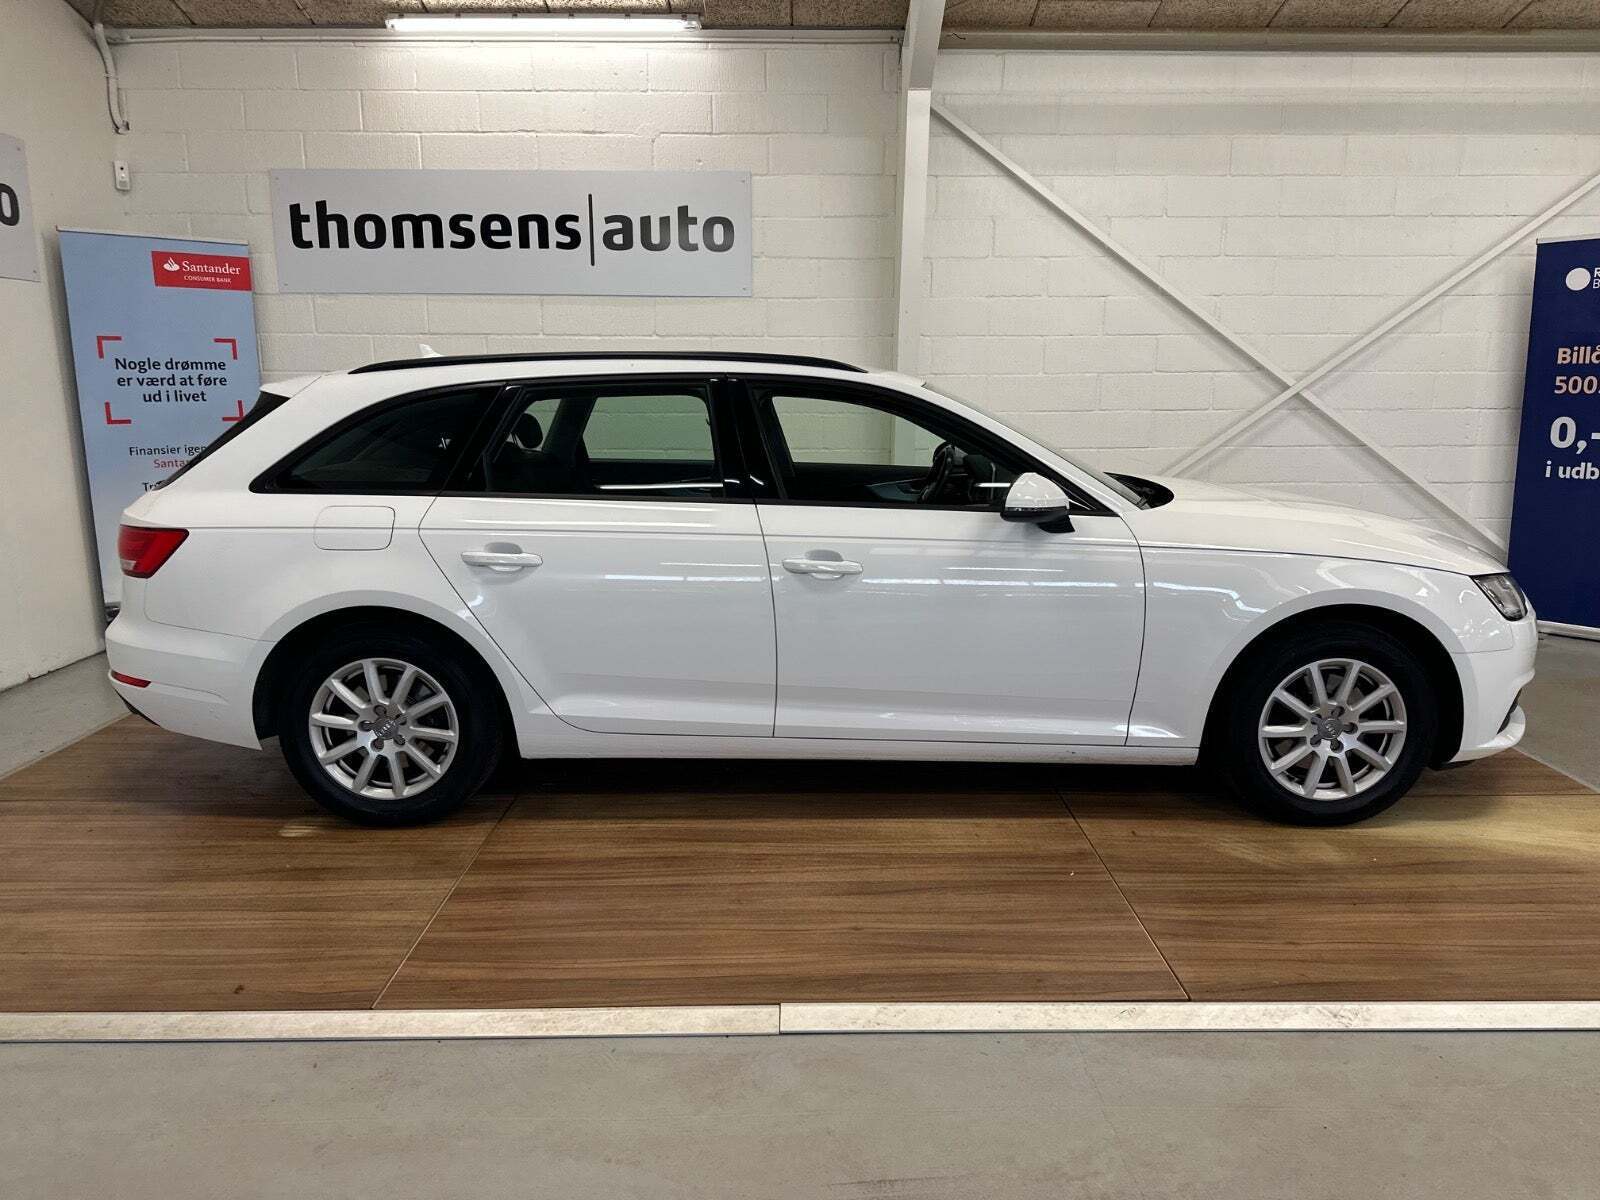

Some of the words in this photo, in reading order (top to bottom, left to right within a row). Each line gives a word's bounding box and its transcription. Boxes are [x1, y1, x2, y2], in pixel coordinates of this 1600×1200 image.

[182, 260, 241, 275] Santander
[114, 357, 161, 374] Nogle
[164, 357, 227, 371] drømme
[116, 376, 133, 387] er
[136, 373, 176, 387] værd
[179, 376, 194, 387] at
[197, 373, 228, 387] føre
[142, 390, 162, 403] ud
[166, 390, 171, 402] i
[174, 390, 208, 403] livet
[129, 445, 181, 457] Finansier
[153, 459, 190, 469] Santa
[1545, 460, 1552, 478] i
[1558, 462, 1600, 480] udb
